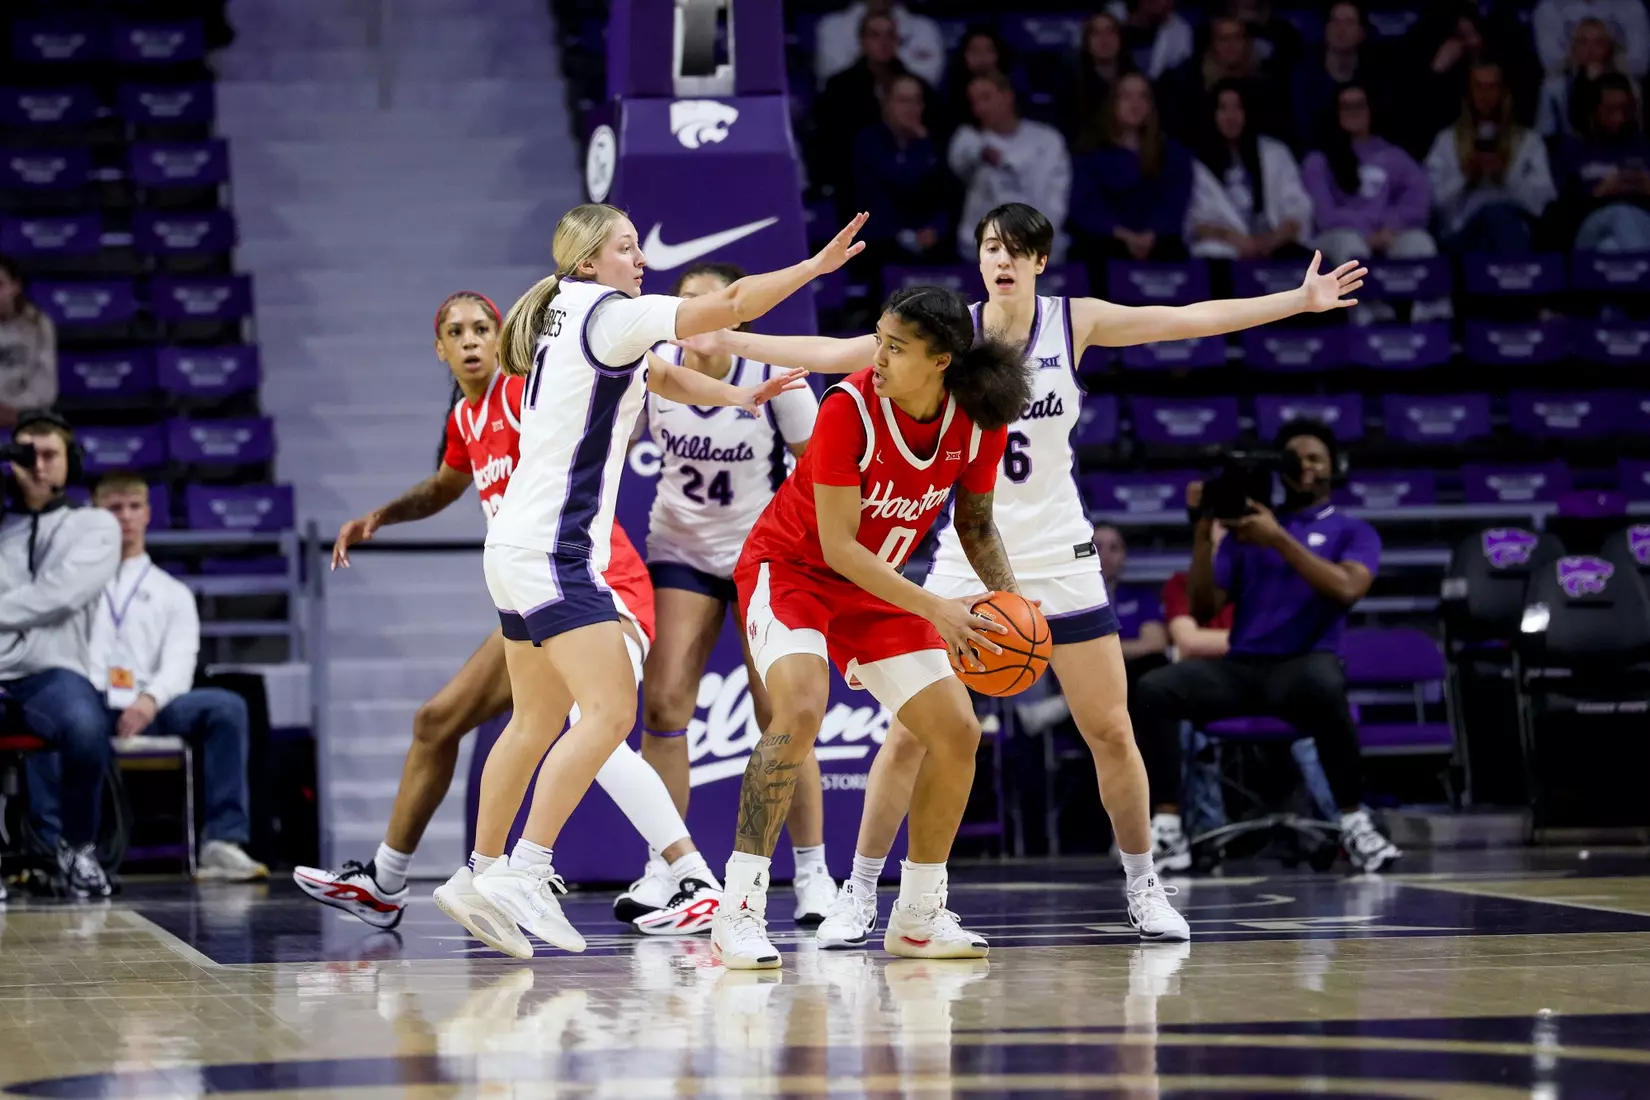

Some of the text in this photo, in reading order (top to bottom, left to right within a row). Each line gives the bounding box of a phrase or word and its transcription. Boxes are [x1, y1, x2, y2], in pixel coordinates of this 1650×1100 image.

[1020, 389, 1065, 420] cats
[660, 428, 755, 463] Wildcats
[1003, 430, 1033, 485] 6
[679, 464, 734, 507] 24
[861, 479, 954, 521] Houston
[876, 526, 918, 570] 0
